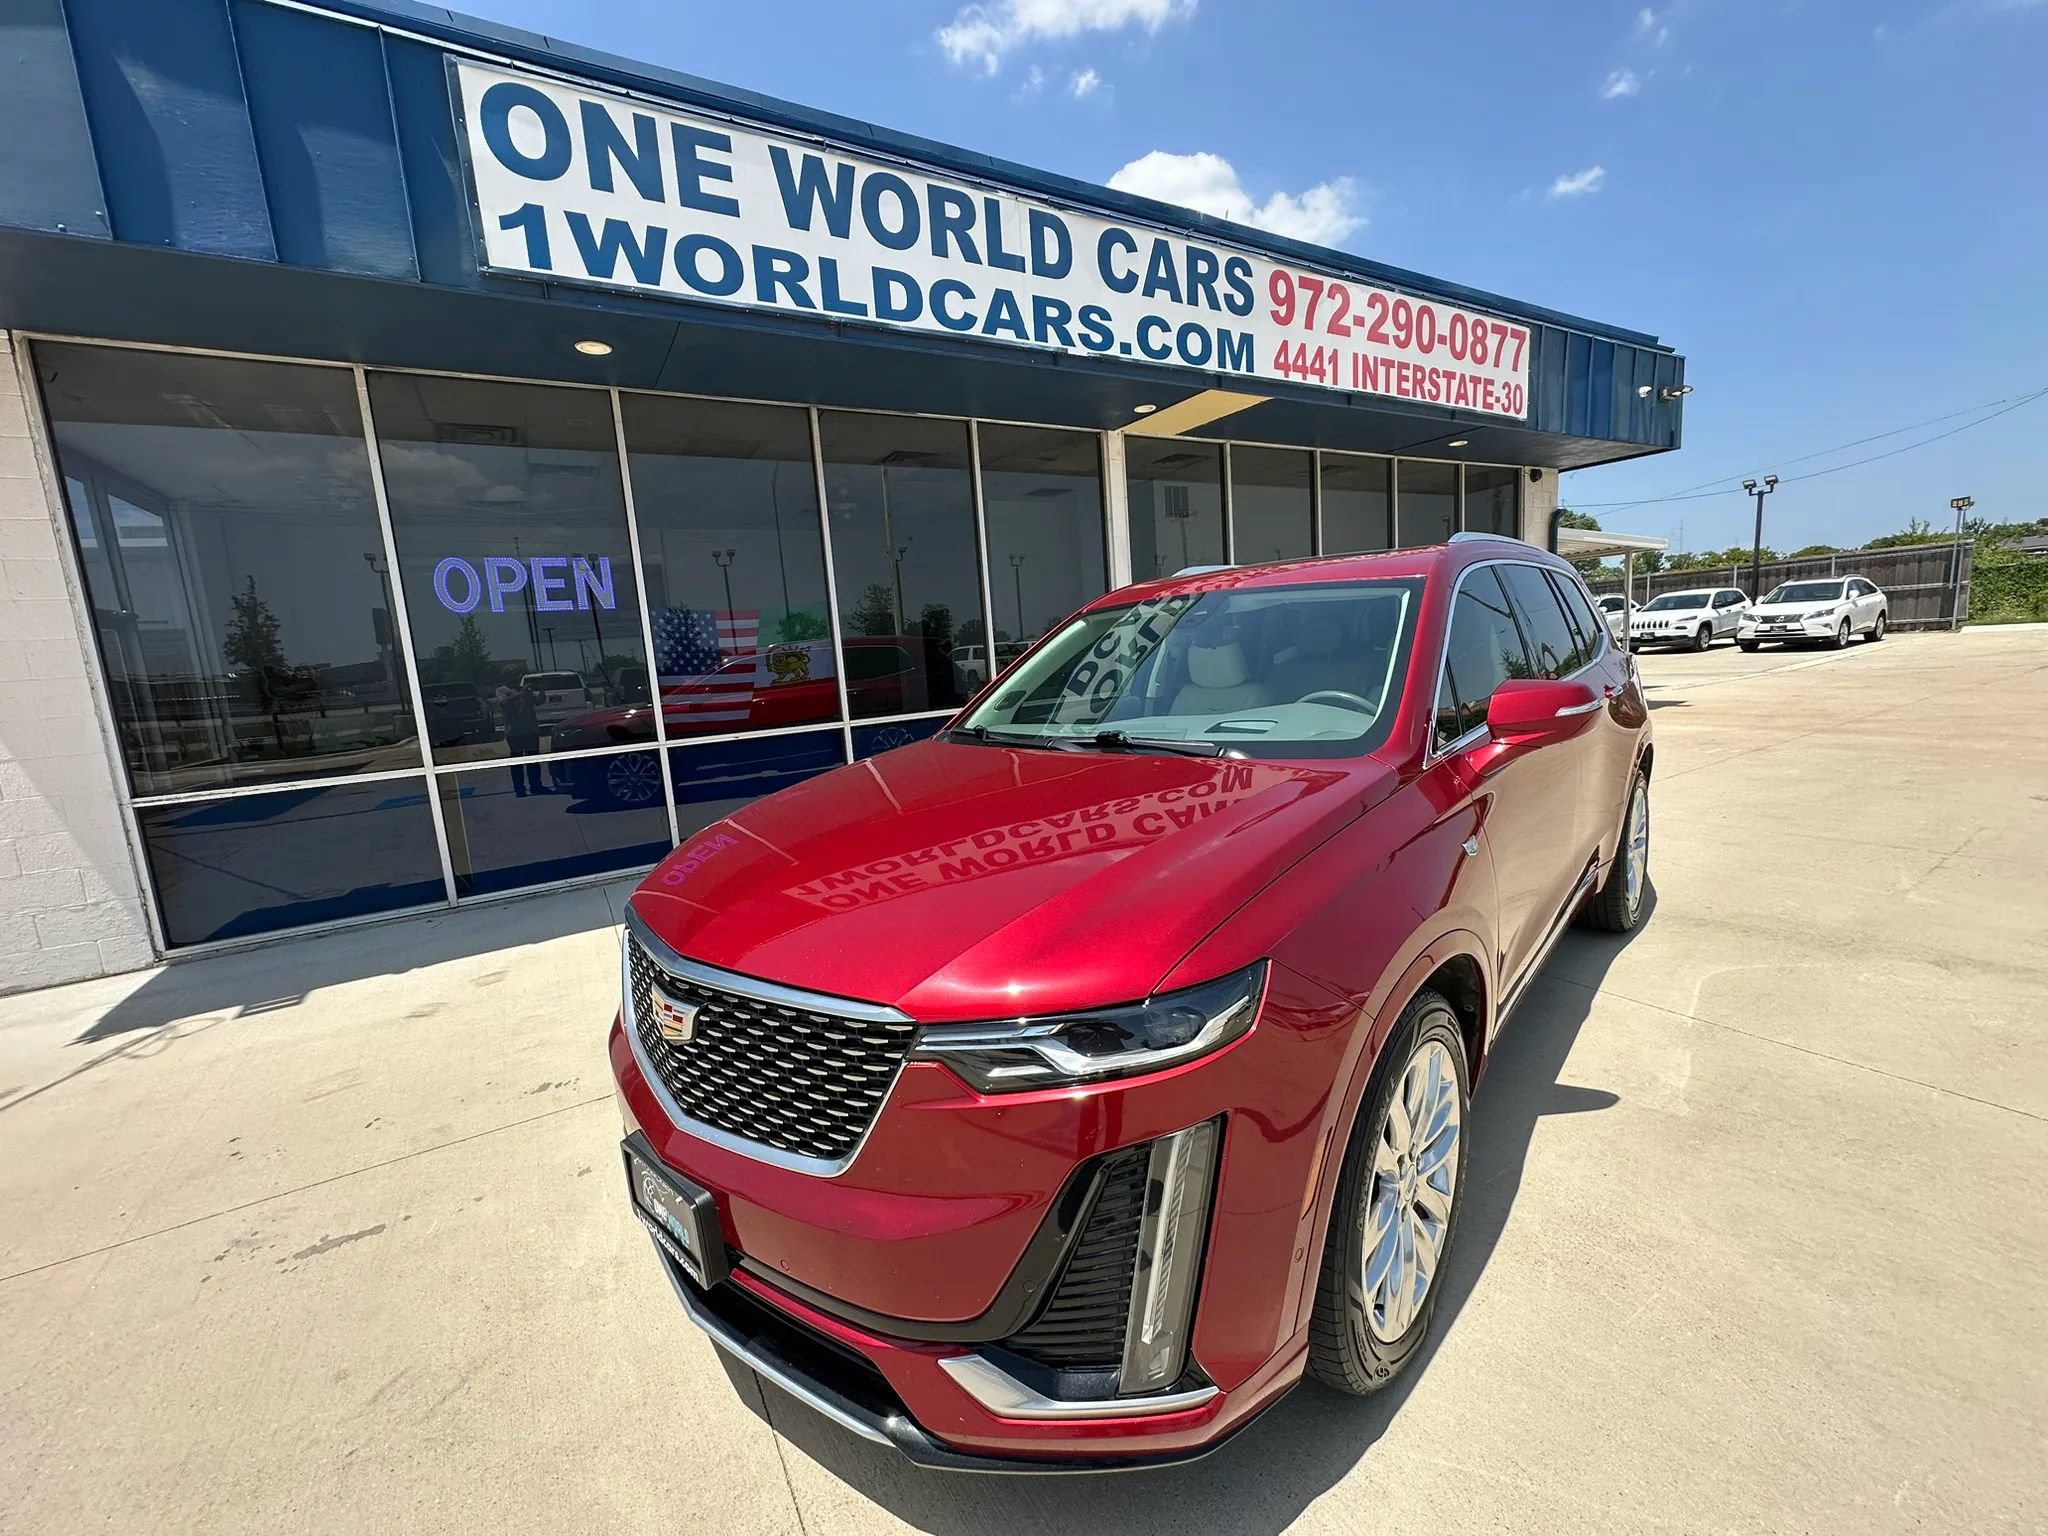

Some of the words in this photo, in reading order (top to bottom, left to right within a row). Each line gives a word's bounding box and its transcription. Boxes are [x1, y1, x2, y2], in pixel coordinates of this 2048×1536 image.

[480, 82, 740, 218] ONE
[767, 144, 1072, 279] WORLD
[1097, 227, 1255, 317] CARS
[498, 202, 1255, 373] 1WORLDCARS.COM
[1269, 269, 1528, 372] 972-290-0877
[1273, 339, 1341, 386] 4441
[1352, 352, 1524, 416] INTERSTATE-30
[433, 556, 616, 614] OPEN
